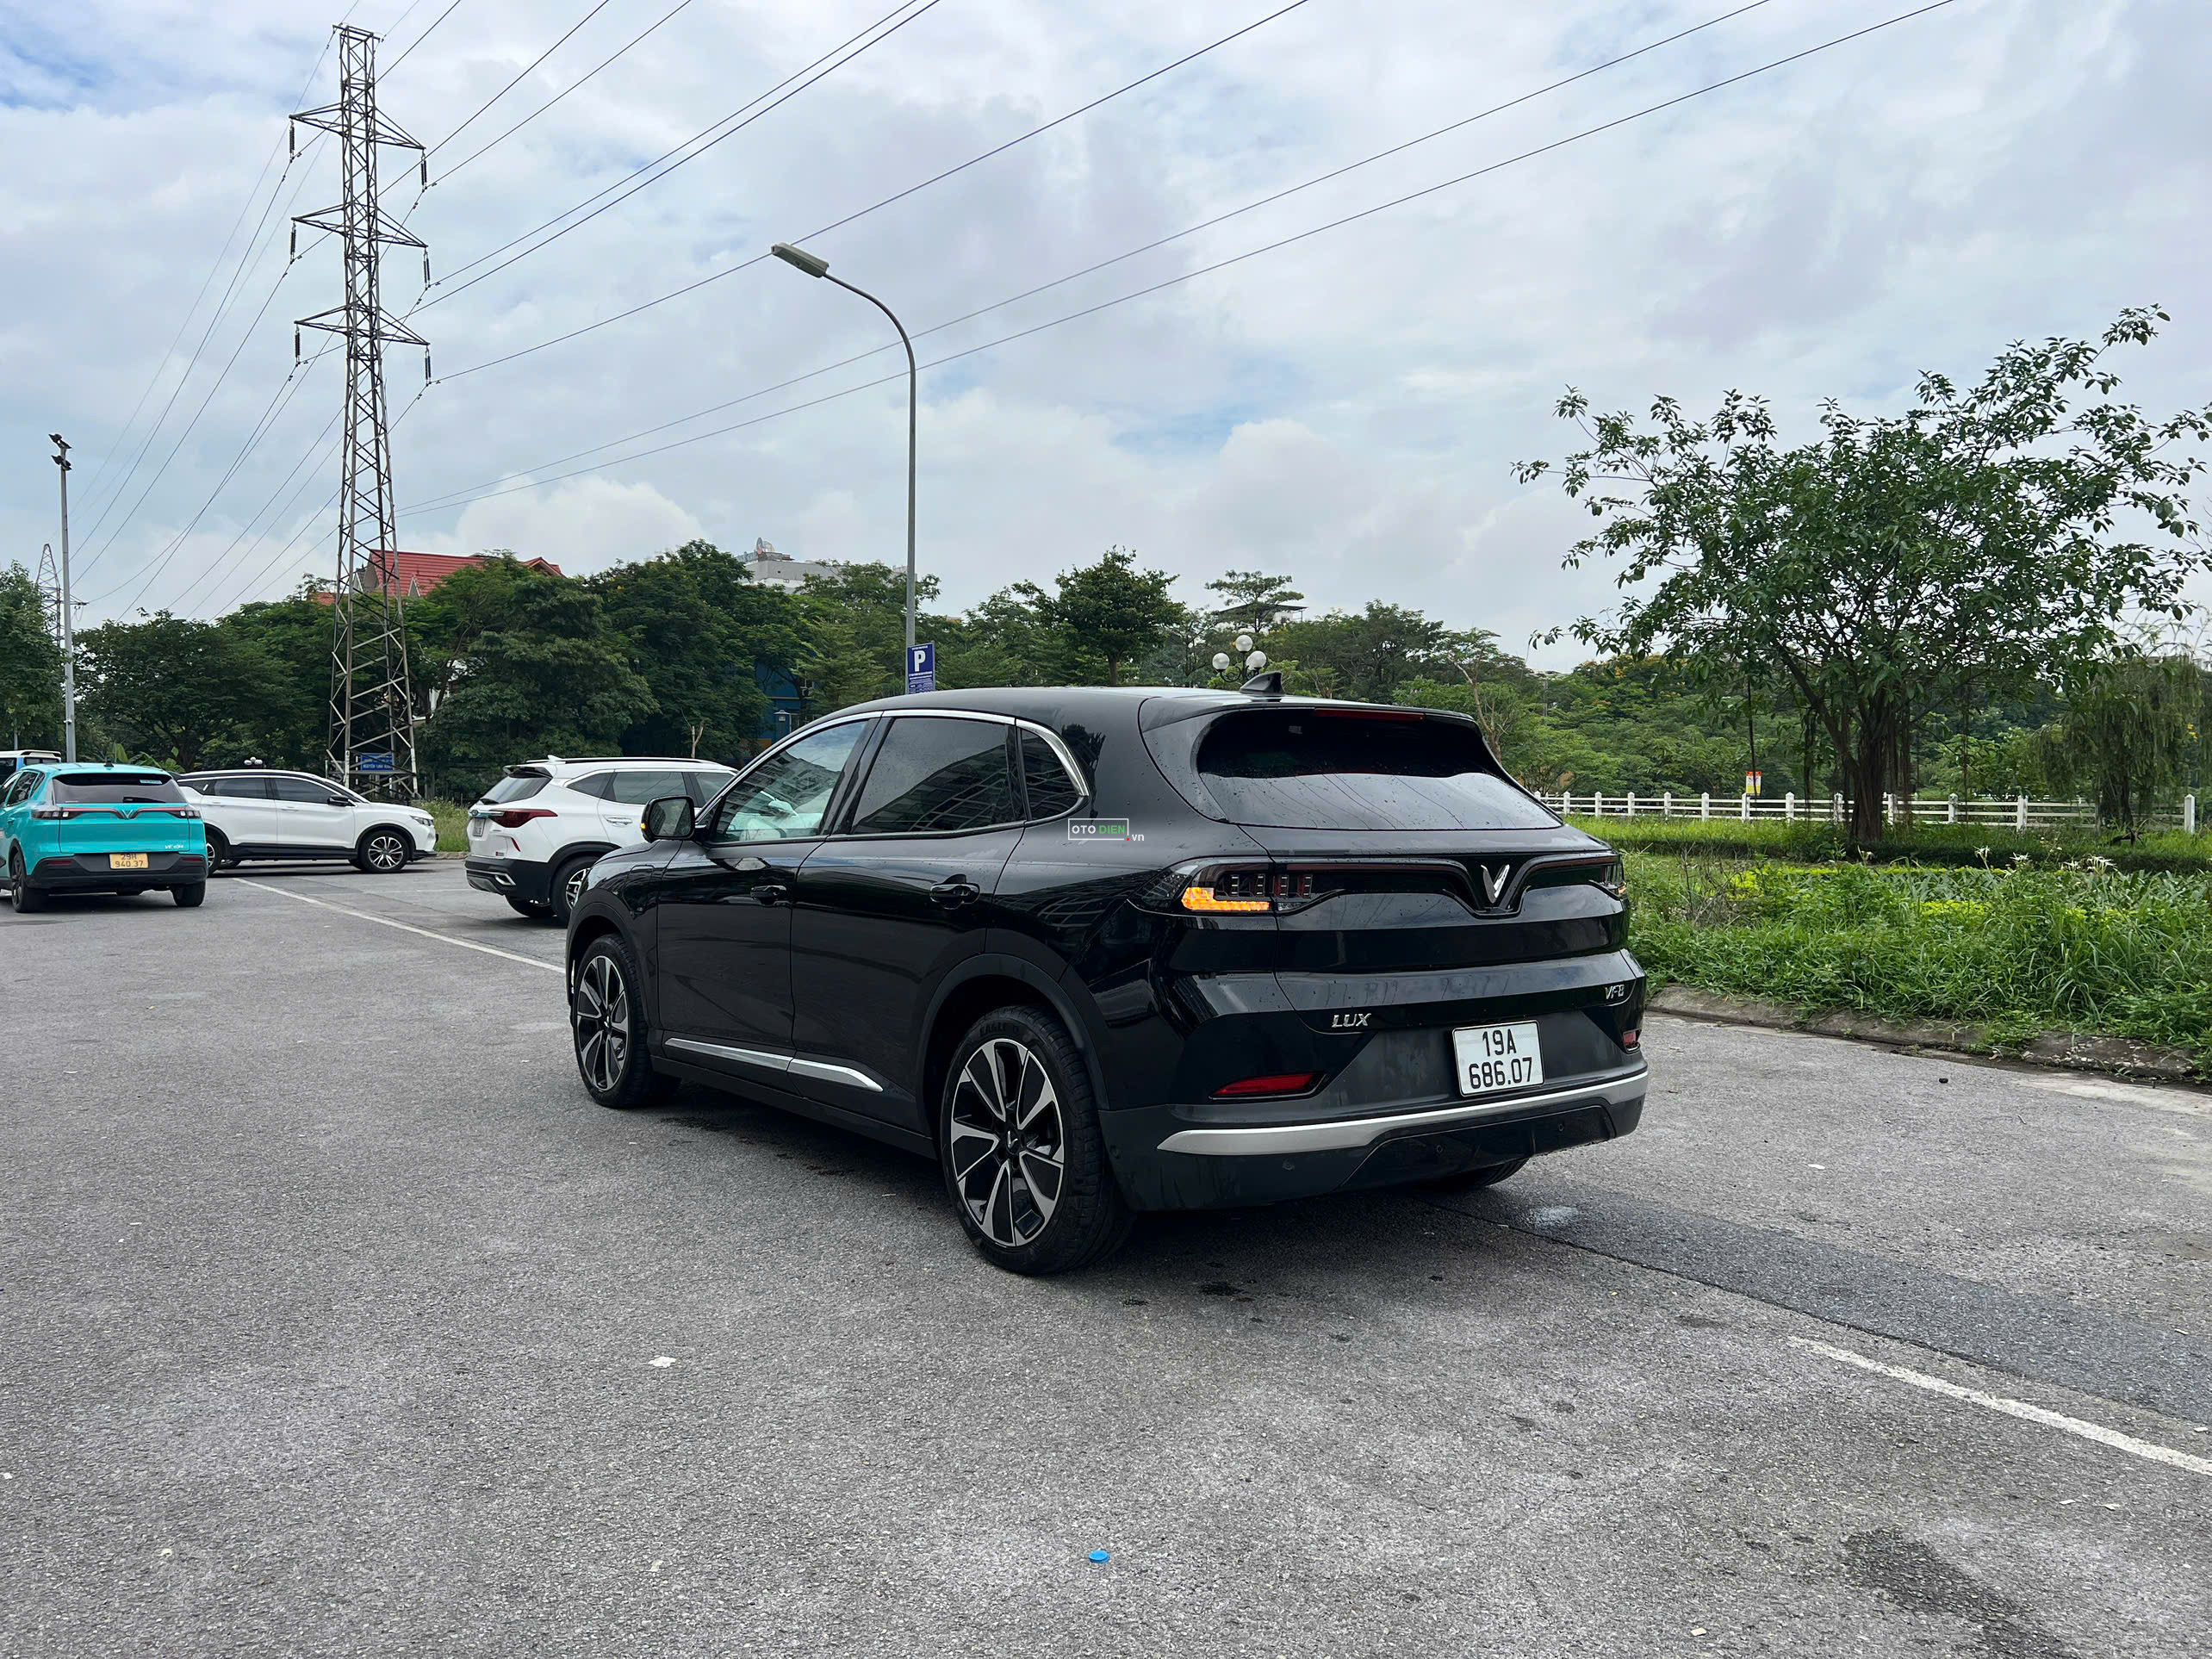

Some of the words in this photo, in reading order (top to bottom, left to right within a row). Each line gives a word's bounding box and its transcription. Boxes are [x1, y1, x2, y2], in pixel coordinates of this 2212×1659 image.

[914, 649, 926, 672] P
[1331, 1013, 1372, 1028] LUX
[1482, 1028, 1517, 1057] 19A
[1469, 1056, 1532, 1089] 686.07
